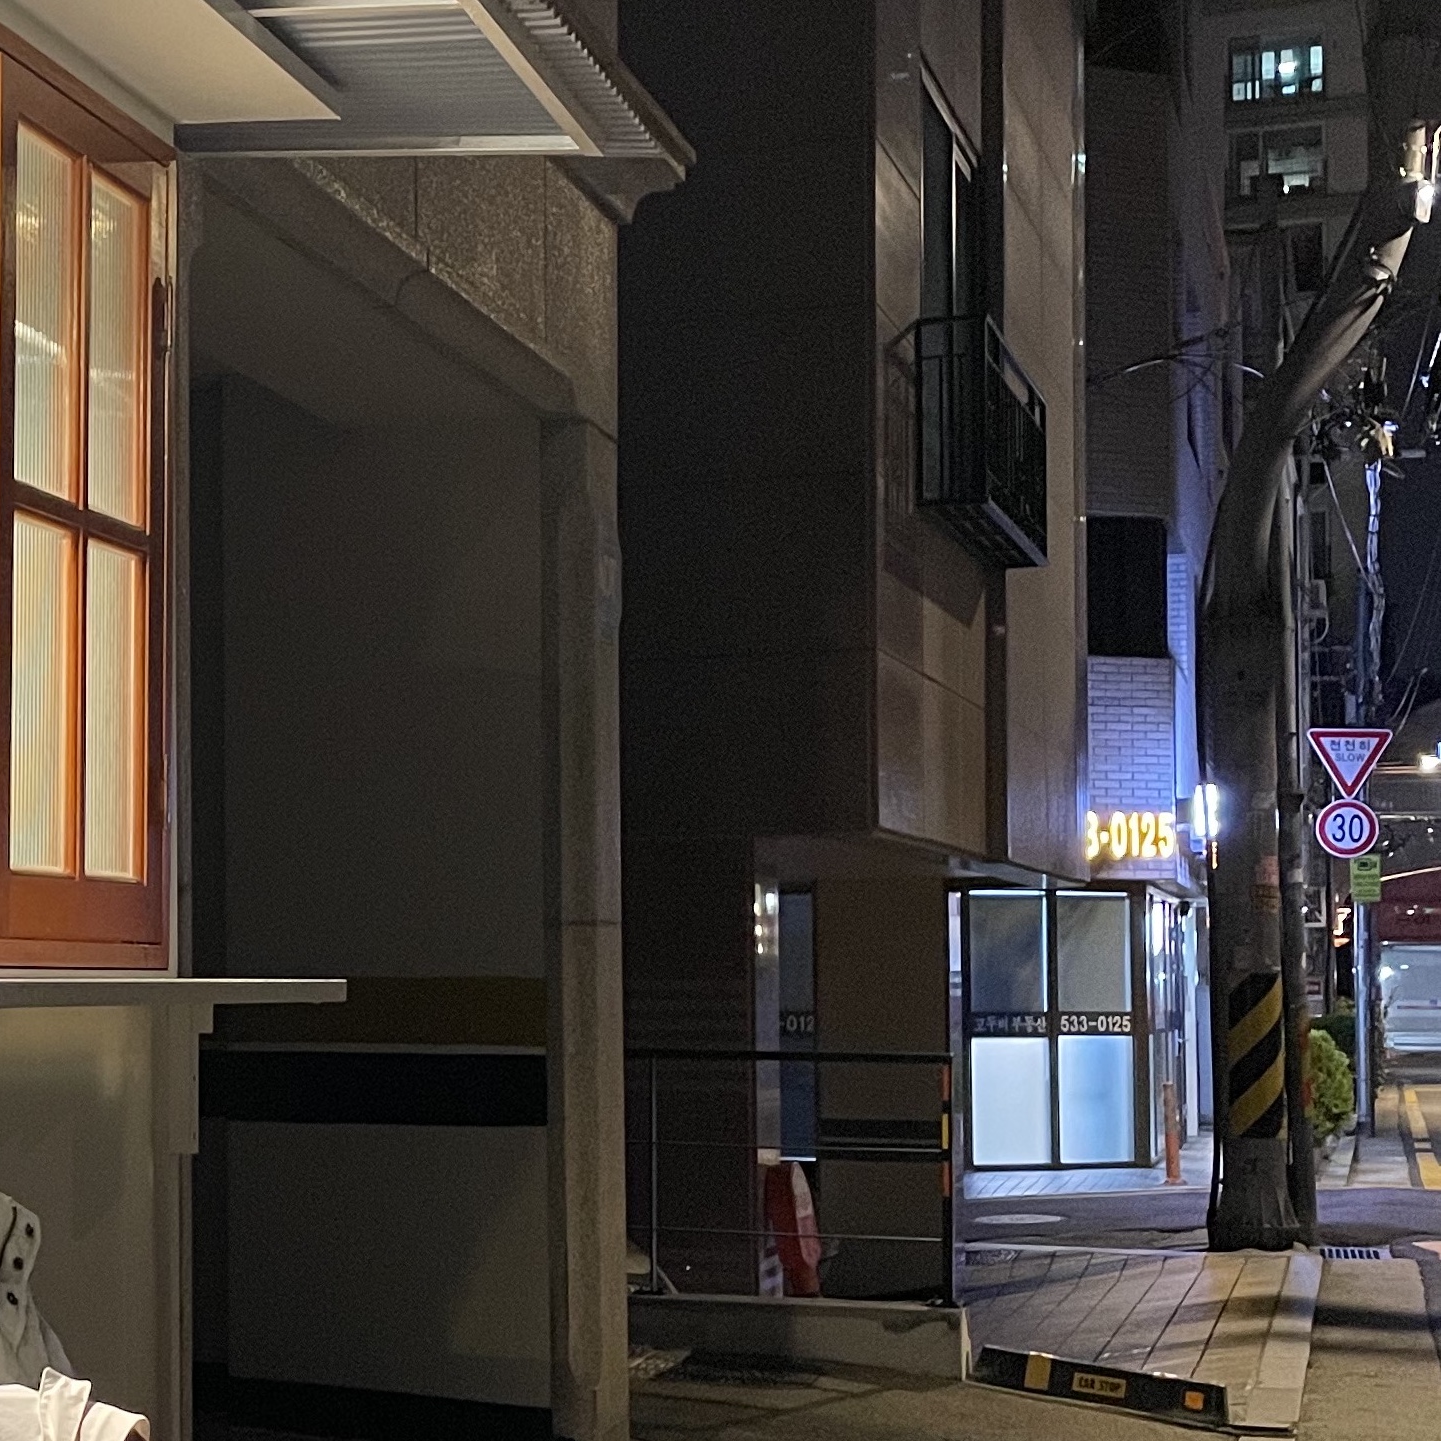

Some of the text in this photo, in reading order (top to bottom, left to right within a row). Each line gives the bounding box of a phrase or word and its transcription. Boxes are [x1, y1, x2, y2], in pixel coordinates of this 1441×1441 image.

[1334, 752, 1366, 763] SLOW
[1332, 814, 1364, 843] 30
[1011, 1015, 1047, 1033] 부동산
[1060, 1015, 1132, 1033] 533-0125
[1098, 1379, 1122, 1393] STOP
